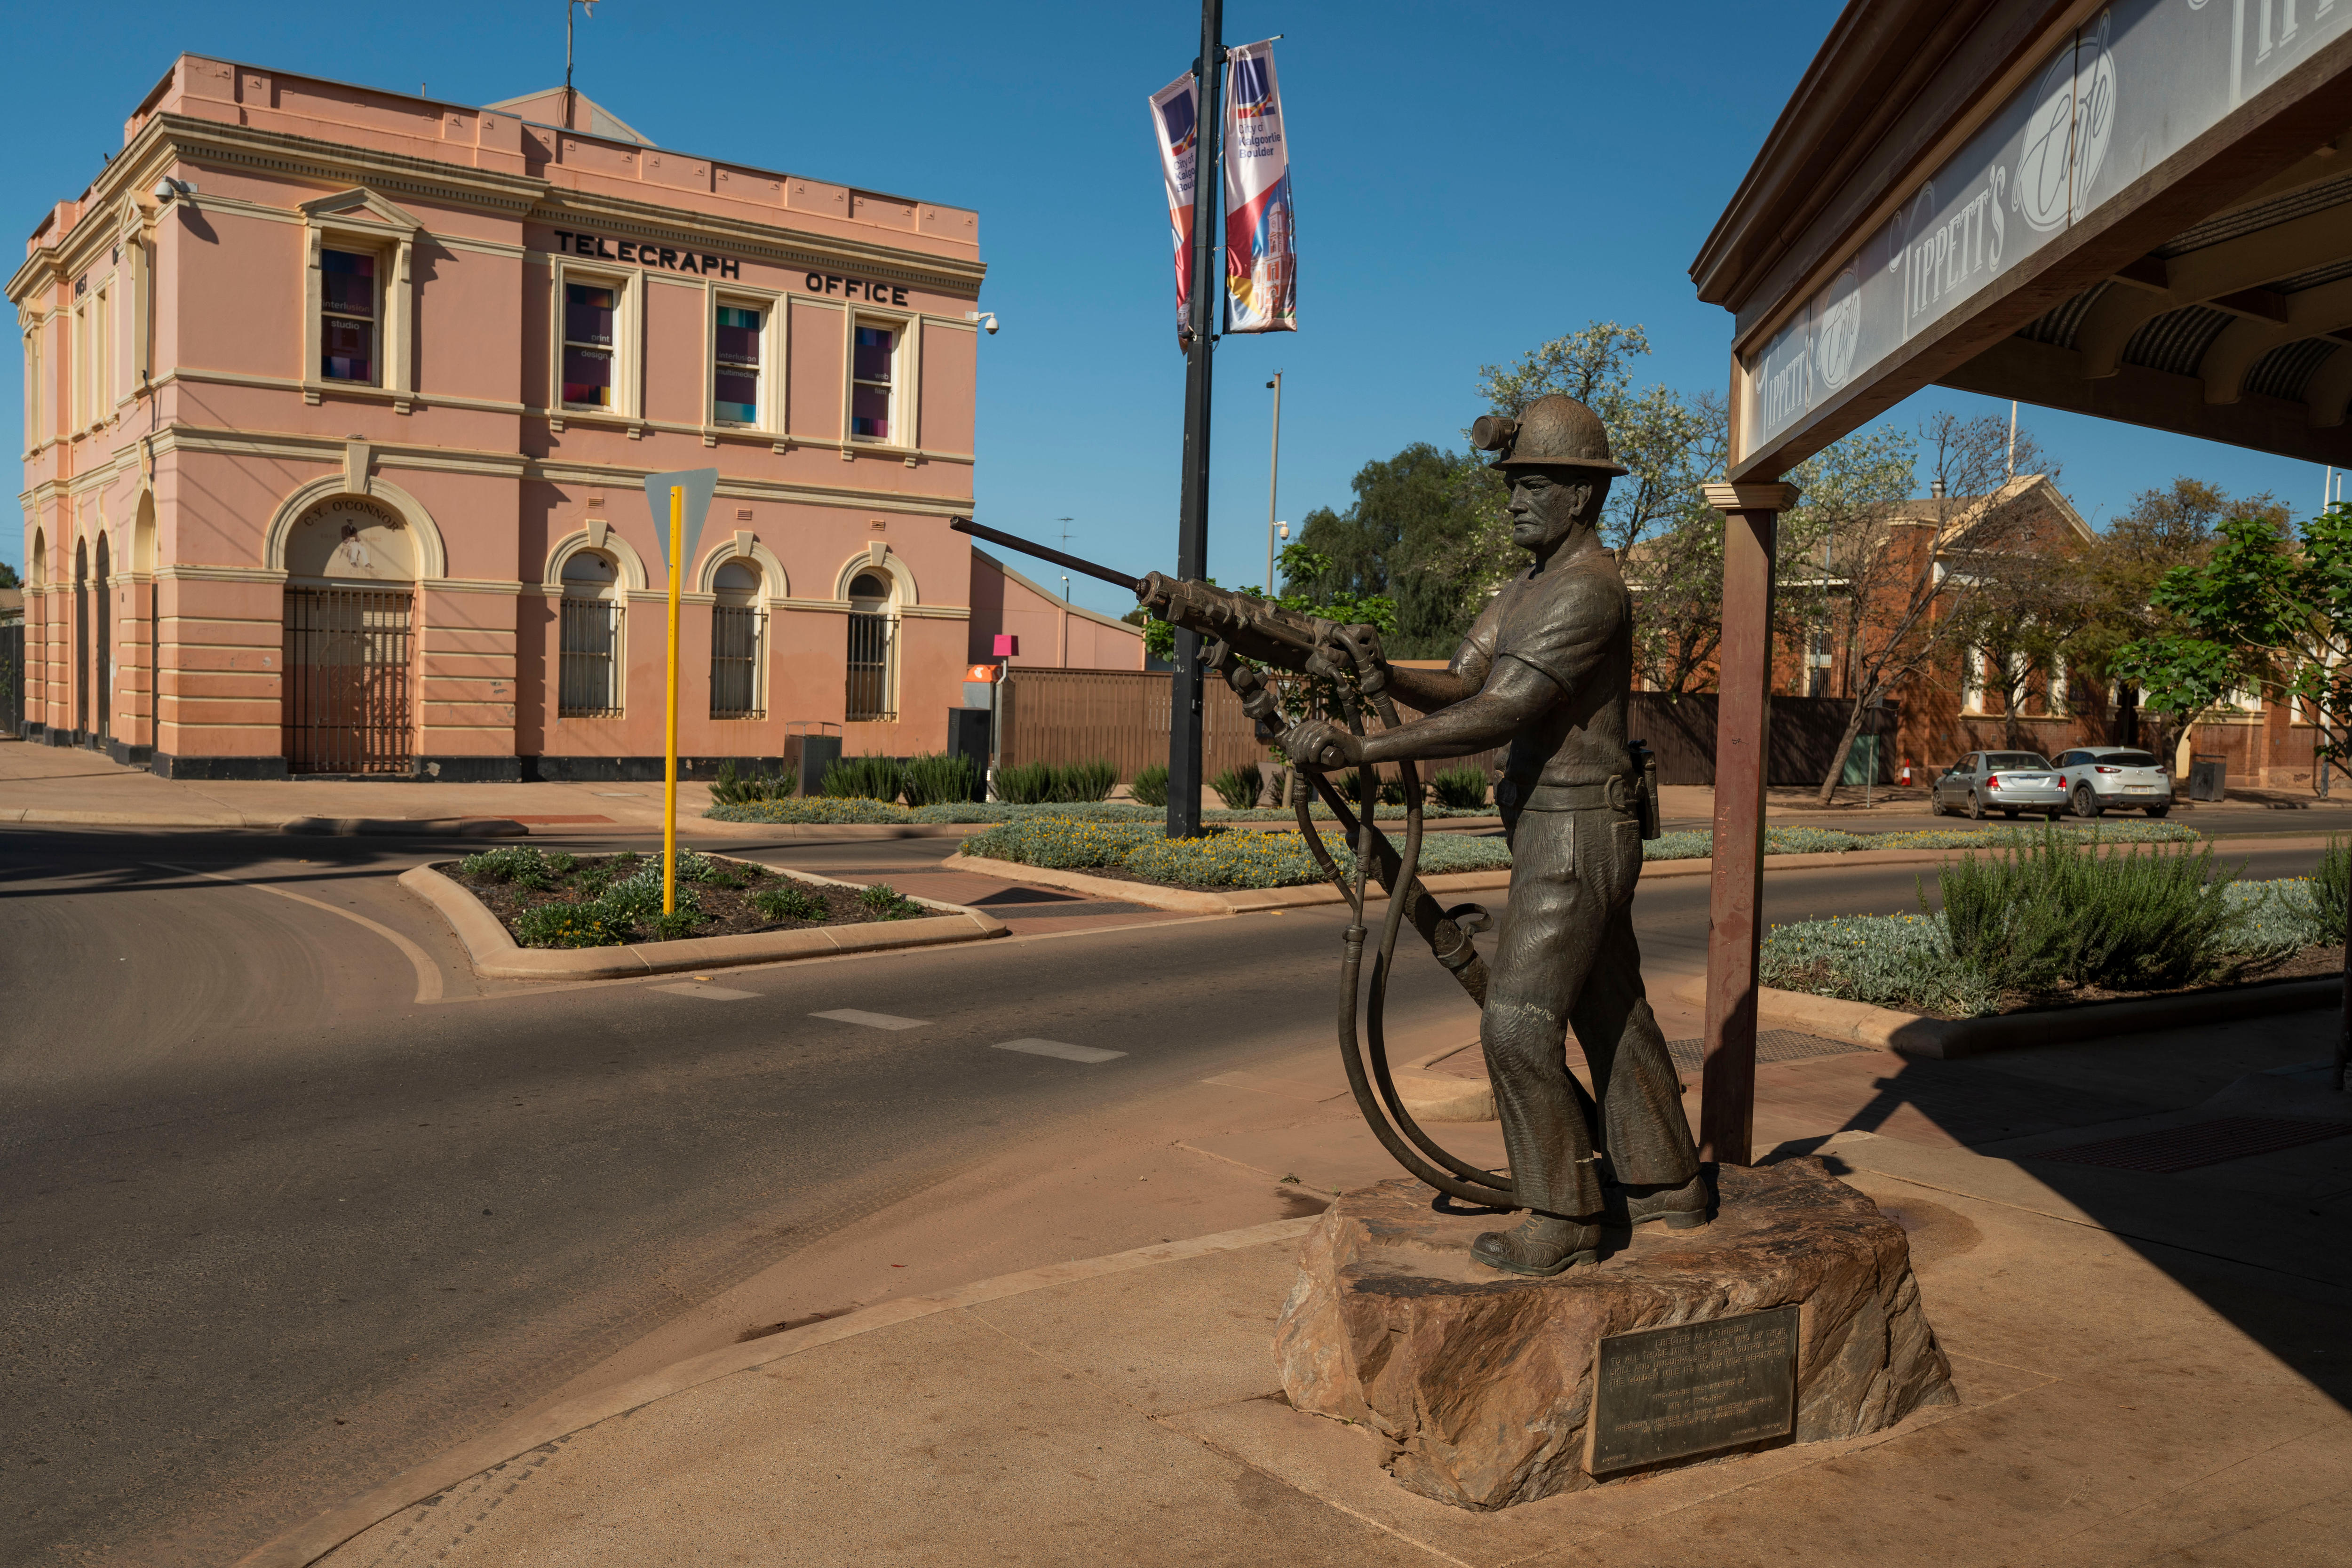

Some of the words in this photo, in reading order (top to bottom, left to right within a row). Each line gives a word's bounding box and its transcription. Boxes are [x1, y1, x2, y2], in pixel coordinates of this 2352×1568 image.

[1239, 124, 1255, 134] City
[1258, 122, 1264, 131] of
[1239, 133, 1281, 147] Kalgoorlie
[1239, 147, 1274, 159] Boulder
[1174, 159, 1188, 171] City
[1188, 153, 1194, 163] of
[555, 230, 740, 280] TELEGRAPH
[806, 272, 909, 307] OFFICE
[75, 273, 87, 300] POST
[323, 300, 370, 313] interlusion
[331, 319, 360, 330] studio
[591, 334, 610, 343] print
[581, 350, 608, 361] design
[719, 351, 756, 362] interlusion
[716, 368, 755, 379] multimedia
[874, 387, 887, 395] film
[303, 508, 328, 527] C.Y.
[333, 500, 399, 533] O'CONNOR
[1655, 1335, 1690, 1348] ERECTED
[1694, 1332, 1705, 1341] AS
[1718, 1324, 1748, 1337] TRIBUTE
[1626, 1354, 1639, 1364] ALL
[1644, 1349, 1668, 1360] THOSE
[1671, 1345, 1691, 1355] MINE
[1694, 1338, 1730, 1352] WORKERS
[1735, 1334, 1750, 1344] WHO
[1755, 1331, 1764, 1340] BY
[1766, 1328, 1787, 1338] THEIR
[1611, 1366, 1631, 1377] SKILL
[1635, 1363, 1651, 1372] AND
[1654, 1353, 1708, 1369] UNSURPASSED
[1713, 1347, 1734, 1358] WORK
[1737, 1342, 1765, 1353] OUTPUT
[1769, 1337, 1786, 1347] GAVE
[1610, 1378, 1625, 1387] THE
[1629, 1372, 1659, 1384] GOLDEN
[1663, 1368, 1680, 1378] MILE
[1683, 1366, 1695, 1374] ITS
[1698, 1361, 1722, 1371] WORLD
[1725, 1356, 1743, 1367] WIDE
[1746, 1348, 1786, 1362] REPUTATION
[1669, 1388, 1690, 1398] STATUE
[1708, 1380, 1735, 1390] UNVEILED
[1704, 1392, 1727, 1404] PARRY
[1616, 1421, 1649, 1432] PRESIDENT
[1653, 1415, 1680, 1425] CHAMBER
[1717, 1402, 1743, 1412] WESTERN
[1712, 1412, 1734, 1420] AUGUST
